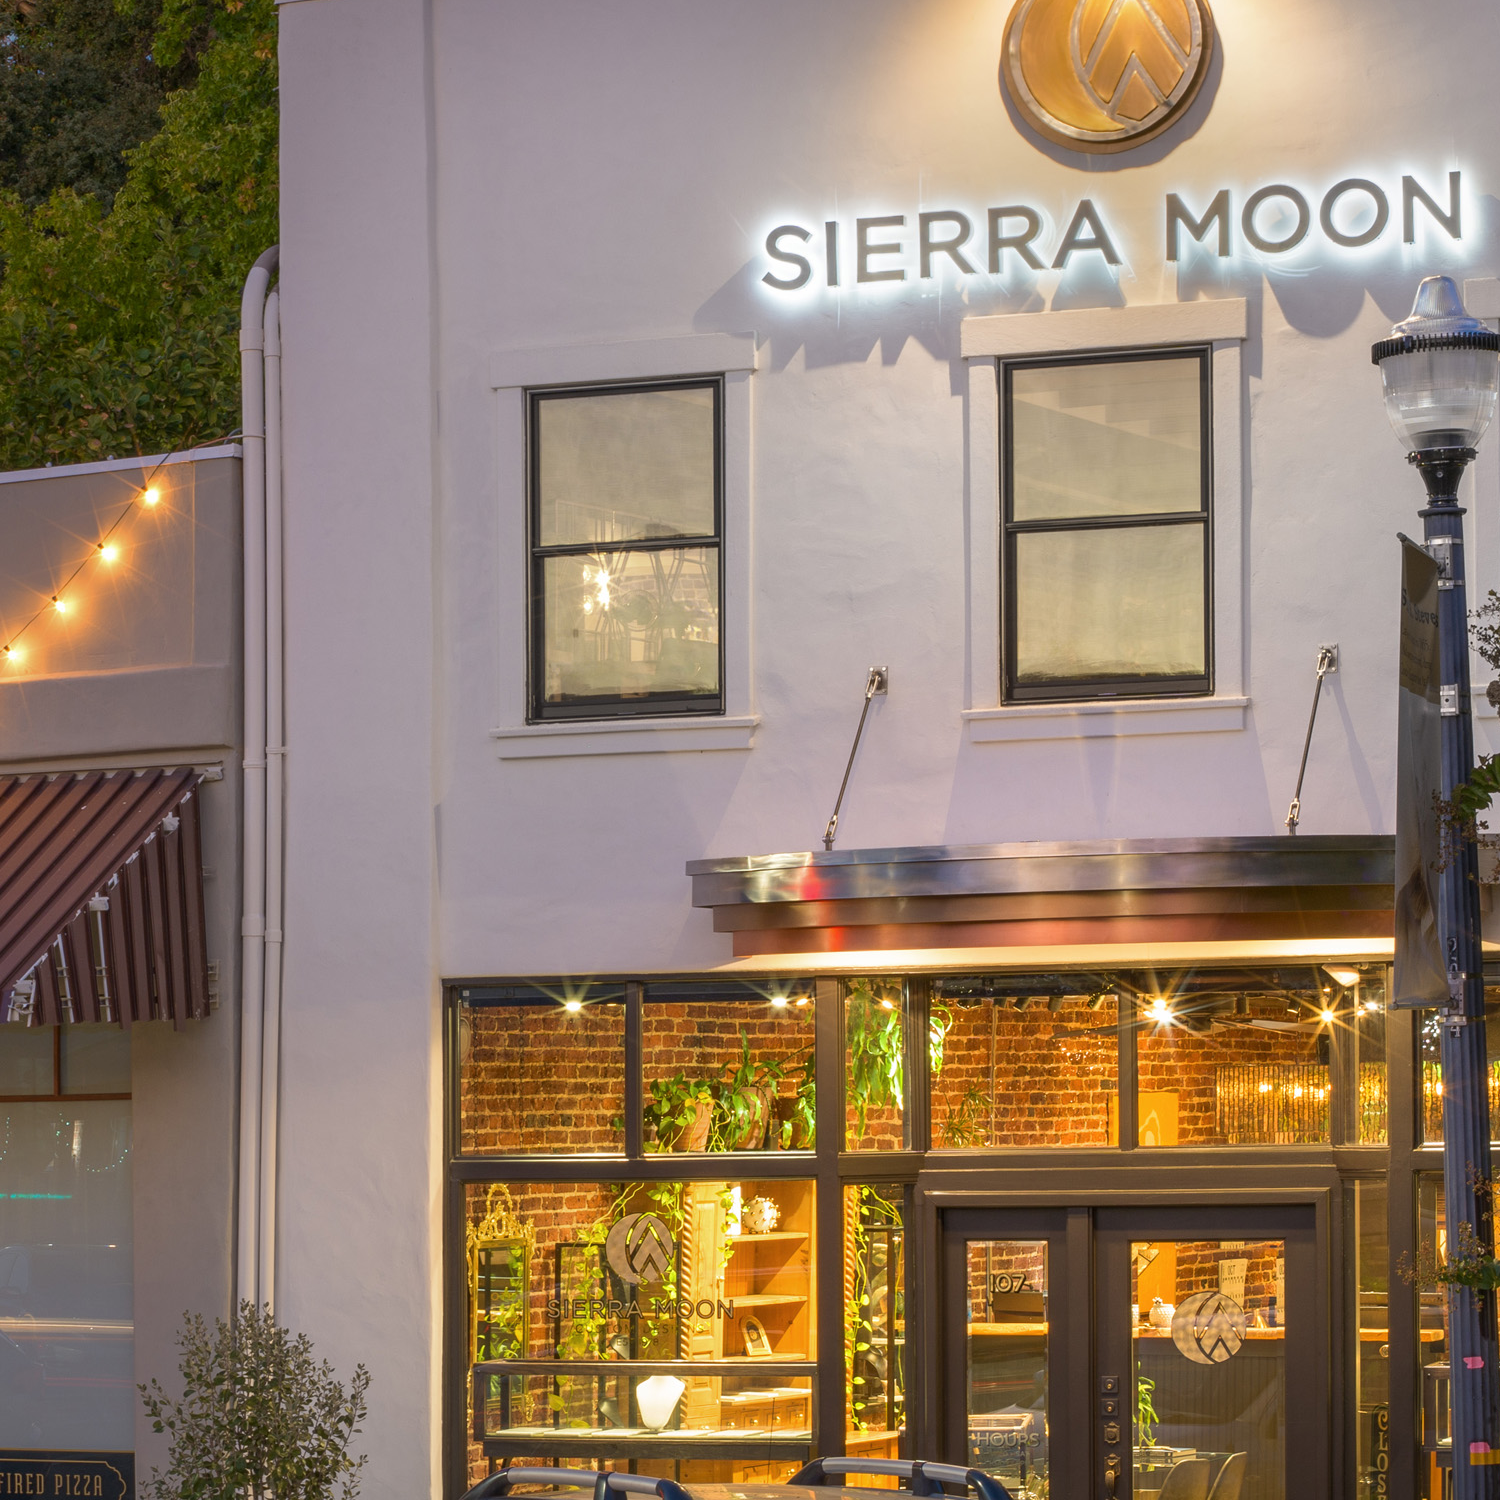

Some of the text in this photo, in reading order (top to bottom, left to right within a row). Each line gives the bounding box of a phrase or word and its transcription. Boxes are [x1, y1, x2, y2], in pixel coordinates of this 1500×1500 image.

[760, 169, 1463, 292] SIERRA MOON
[989, 1273, 1027, 1293] 107
[547, 1299, 735, 1320] SIERRA MOON
[976, 1432, 1040, 1447] HOURS
[54, 1473, 103, 1497] PIZZA
